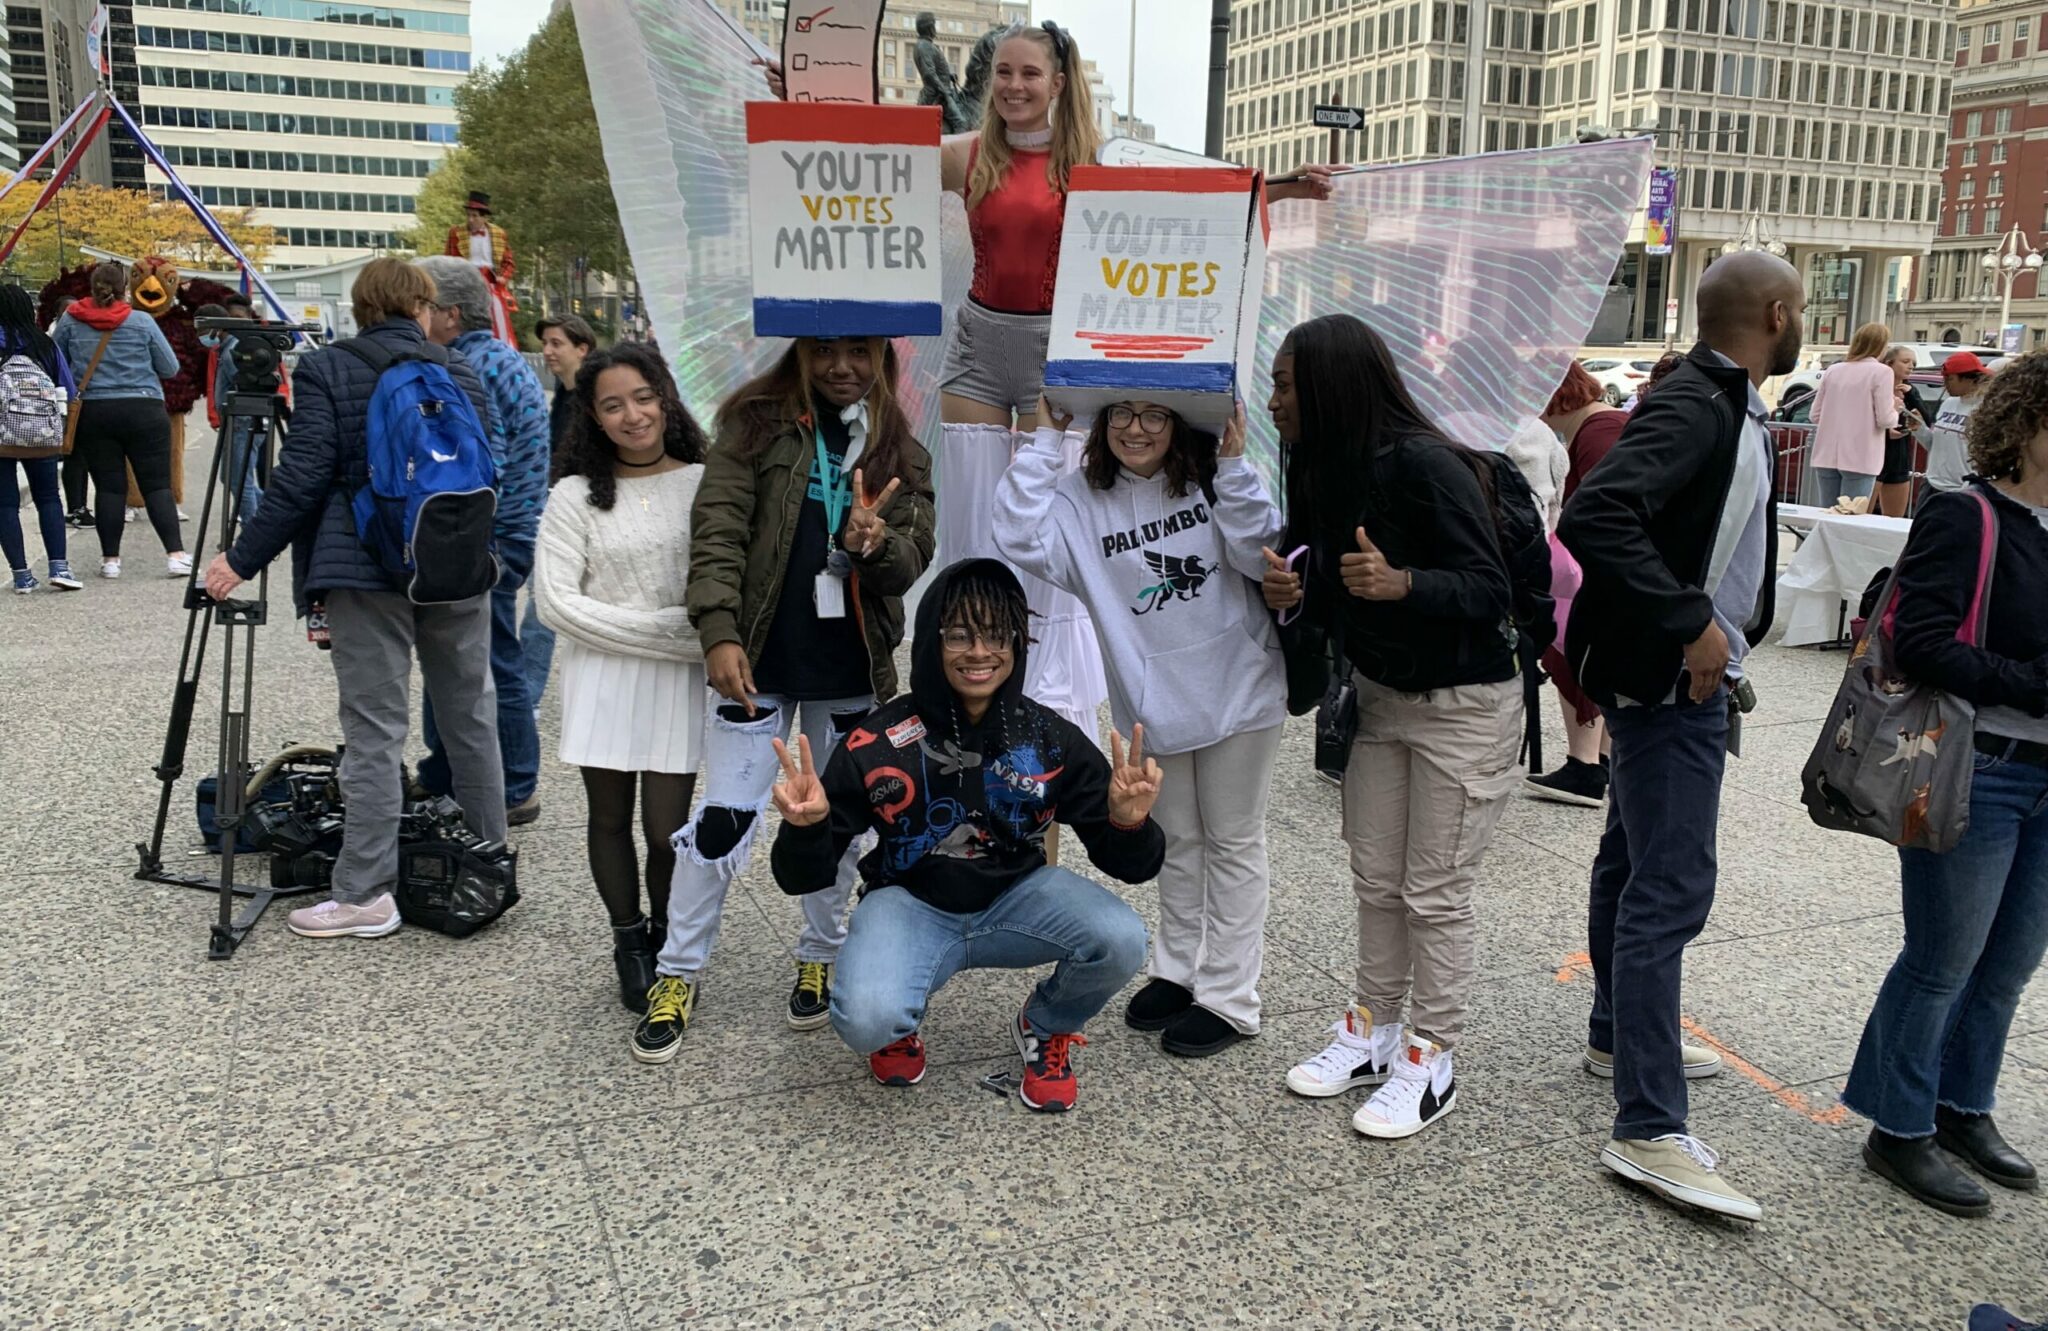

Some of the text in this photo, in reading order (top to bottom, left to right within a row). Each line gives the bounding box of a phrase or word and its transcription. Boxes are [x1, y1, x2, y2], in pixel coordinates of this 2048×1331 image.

[1318, 111, 1350, 122] ONE WAY
[781, 150, 912, 193] YOUTH
[800, 194, 893, 224] VOTES
[775, 225, 926, 271] MATTER
[1082, 209, 1209, 257] YOUTH
[1101, 257, 1221, 298] VOTES
[1102, 503, 1209, 558] PALUMBO
[990, 760, 1045, 799] NASA
